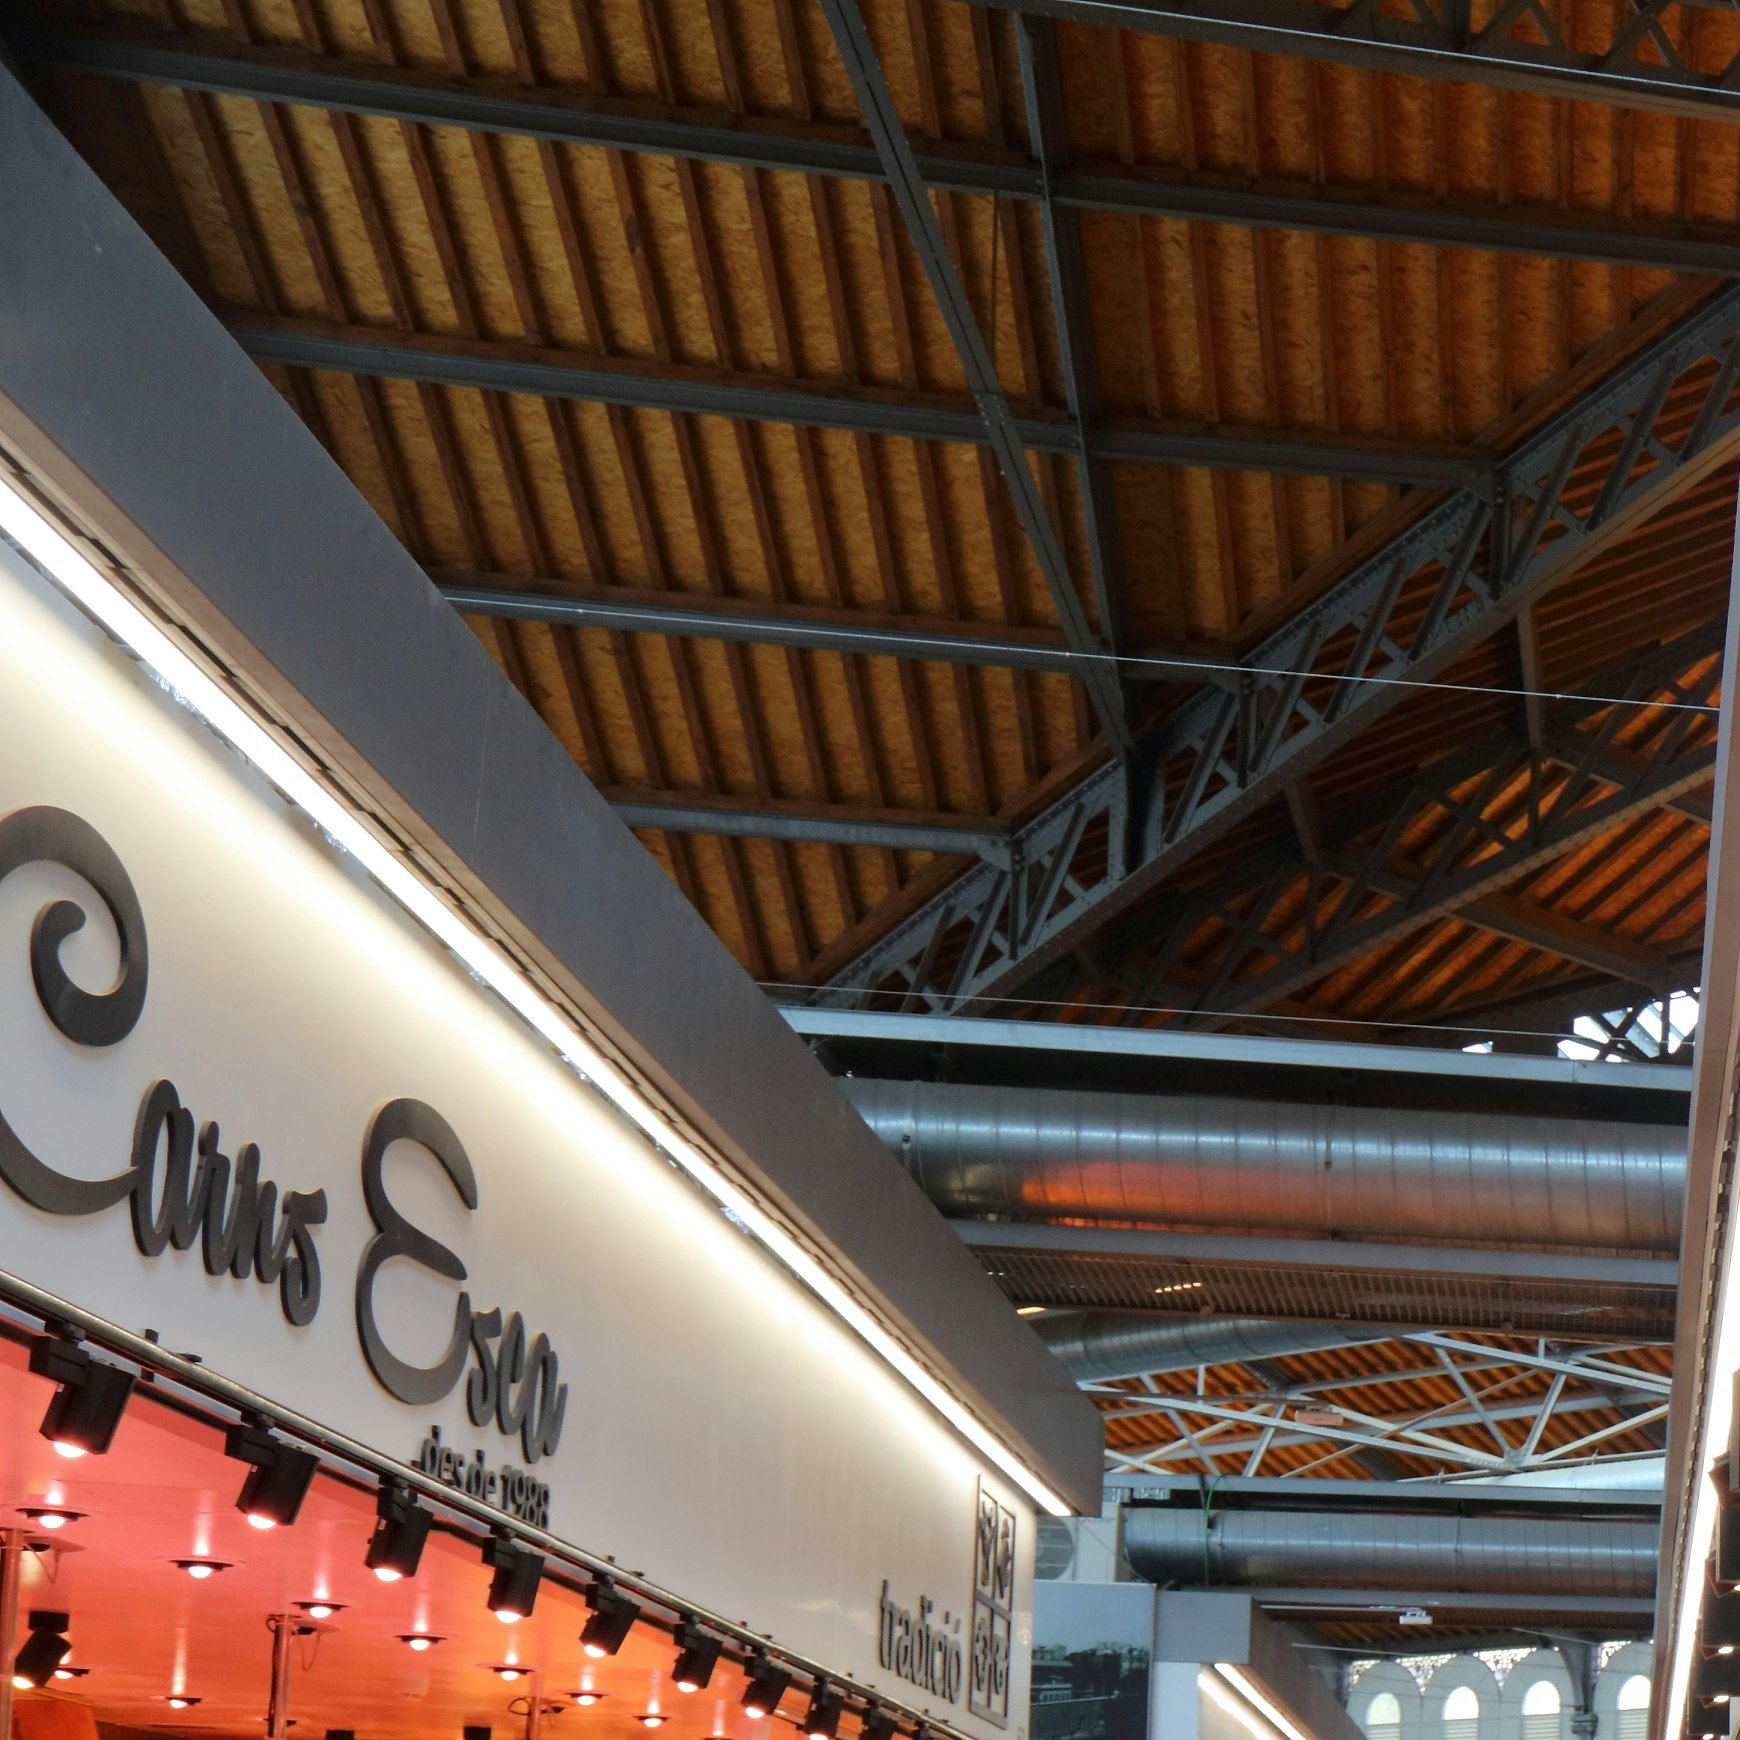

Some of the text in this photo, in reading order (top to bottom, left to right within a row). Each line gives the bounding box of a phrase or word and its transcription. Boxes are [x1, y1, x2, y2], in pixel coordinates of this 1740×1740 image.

[0, 805, 568, 1464] Carns Esca
[499, 1464, 551, 1531] 1988
[879, 1578, 962, 1705] tradició
